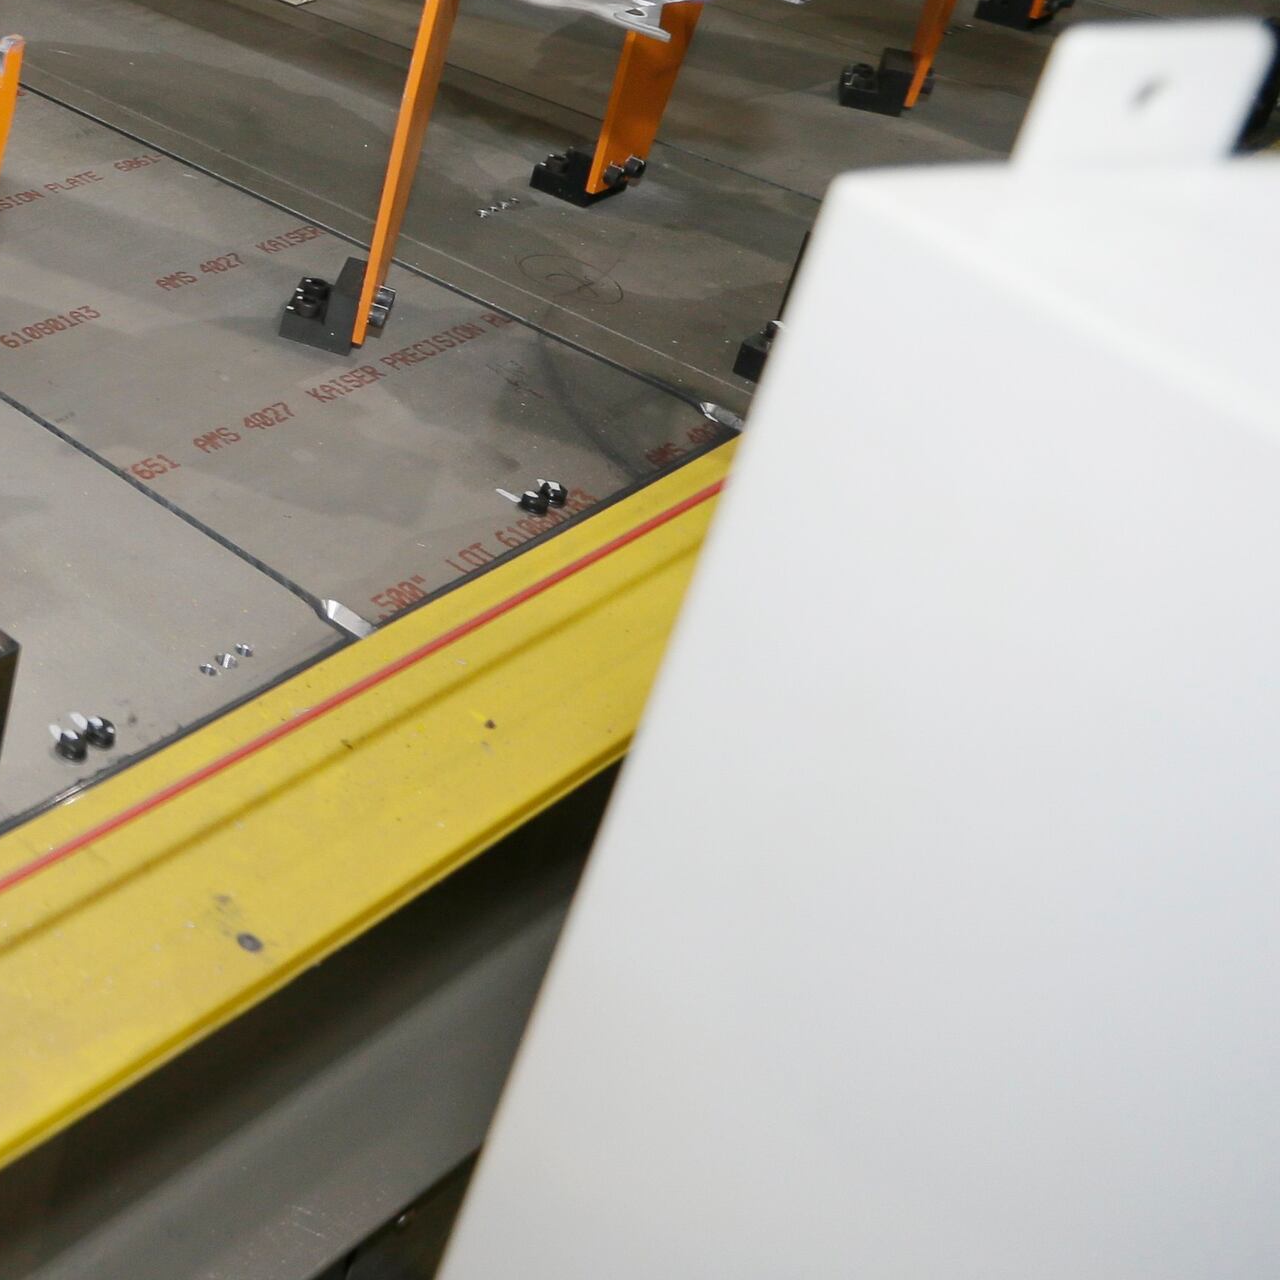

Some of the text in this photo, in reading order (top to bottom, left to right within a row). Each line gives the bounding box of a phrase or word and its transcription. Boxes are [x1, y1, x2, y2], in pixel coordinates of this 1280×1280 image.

[43, 169, 105, 195] PLATE
[154, 270, 199, 292] AMS
[197, 251, 246, 276] 4027
[254, 225, 326, 255] KAISER
[129, 452, 182, 481] 651
[192, 426, 242, 454] AMS
[243, 400, 297, 432] 4027
[303, 363, 388, 404] KAISER
[379, 322, 488, 372] PRECISION
[444, 541, 499, 575] LOT
